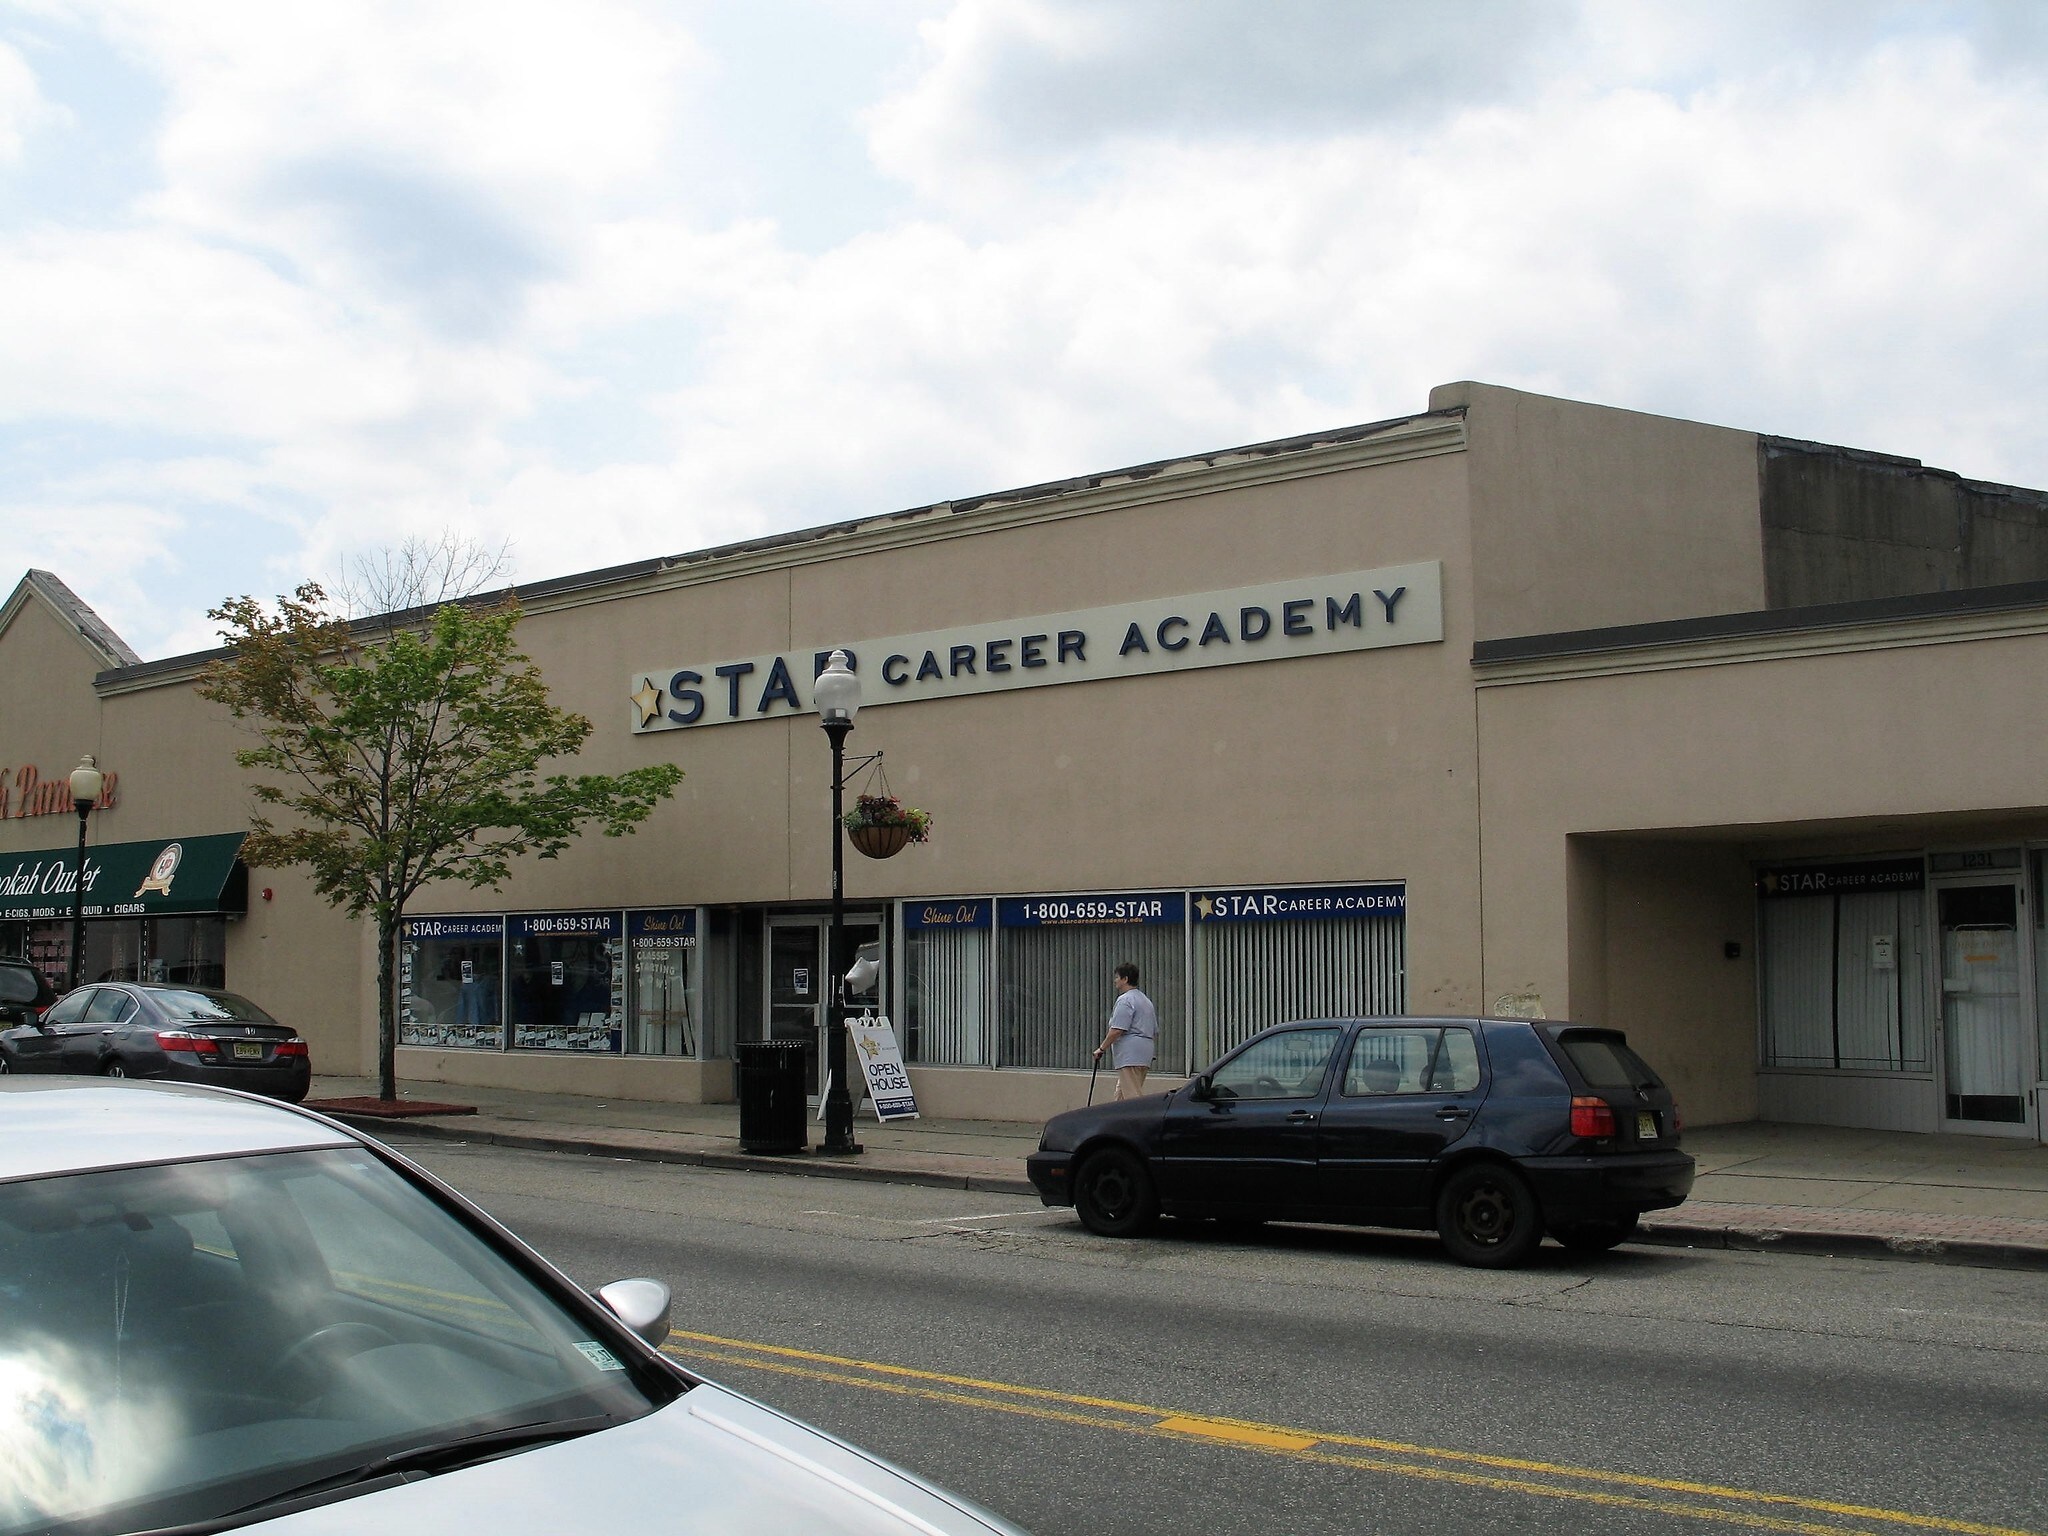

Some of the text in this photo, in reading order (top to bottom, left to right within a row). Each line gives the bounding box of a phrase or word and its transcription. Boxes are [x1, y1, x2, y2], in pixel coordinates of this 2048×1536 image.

[881, 630, 1086, 686] CAREER
[1118, 586, 1407, 656] ACADEMY
[1963, 852, 1993, 867] 1231
[0, 861, 42, 896] okah
[1780, 871, 1920, 892] STAR CAREER ACADEMY
[33, 907, 55, 917] MODS
[114, 903, 145, 914] CIGARS
[1023, 900, 1162, 919] 1-800-659-STAR
[1215, 895, 1405, 916] STAR CAREER ACADEMY
[921, 905, 977, 924] Shine On!
[412, 921, 441, 936] STAR
[442, 924, 469, 934] CAREER
[523, 916, 611, 932] 1-800-659-STAR
[632, 936, 696, 948] 1-800-659-STAR
[869, 1062, 901, 1076] OPEN
[870, 1076, 909, 1091] HOUSE
